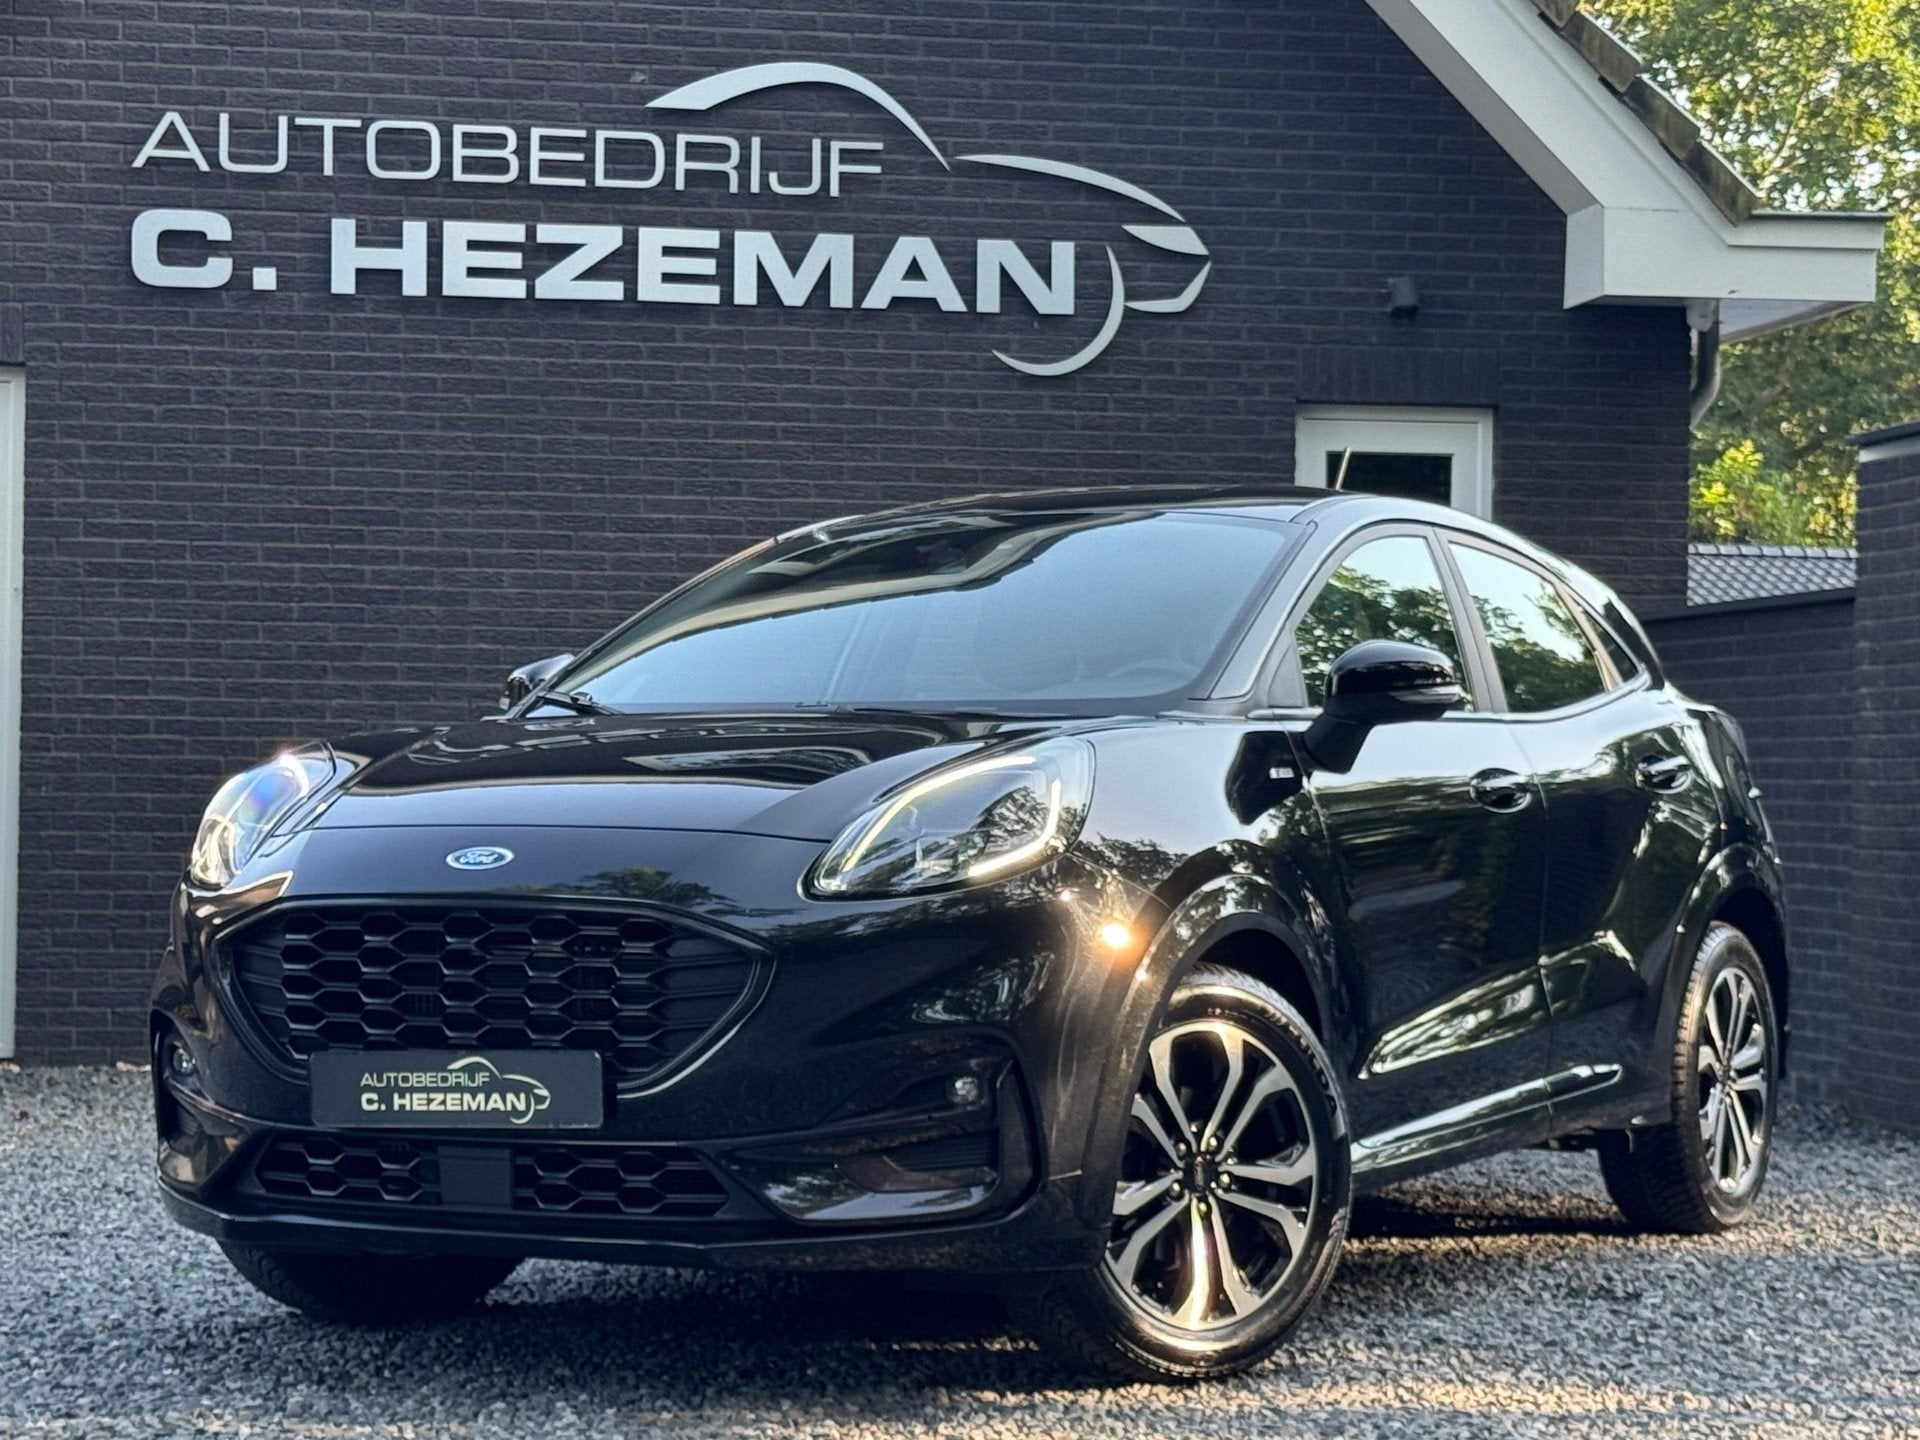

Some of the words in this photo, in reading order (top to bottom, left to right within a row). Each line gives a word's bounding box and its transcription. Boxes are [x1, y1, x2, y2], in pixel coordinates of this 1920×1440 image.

[131, 111, 884, 197] AUTOBEDRIJF
[131, 208, 277, 291] C.
[330, 217, 1075, 315] HEZEMAN
[360, 1071, 491, 1087] AUTOBEDRIJF
[361, 1092, 386, 1111] C.
[393, 1092, 526, 1111] HEZEMAN
